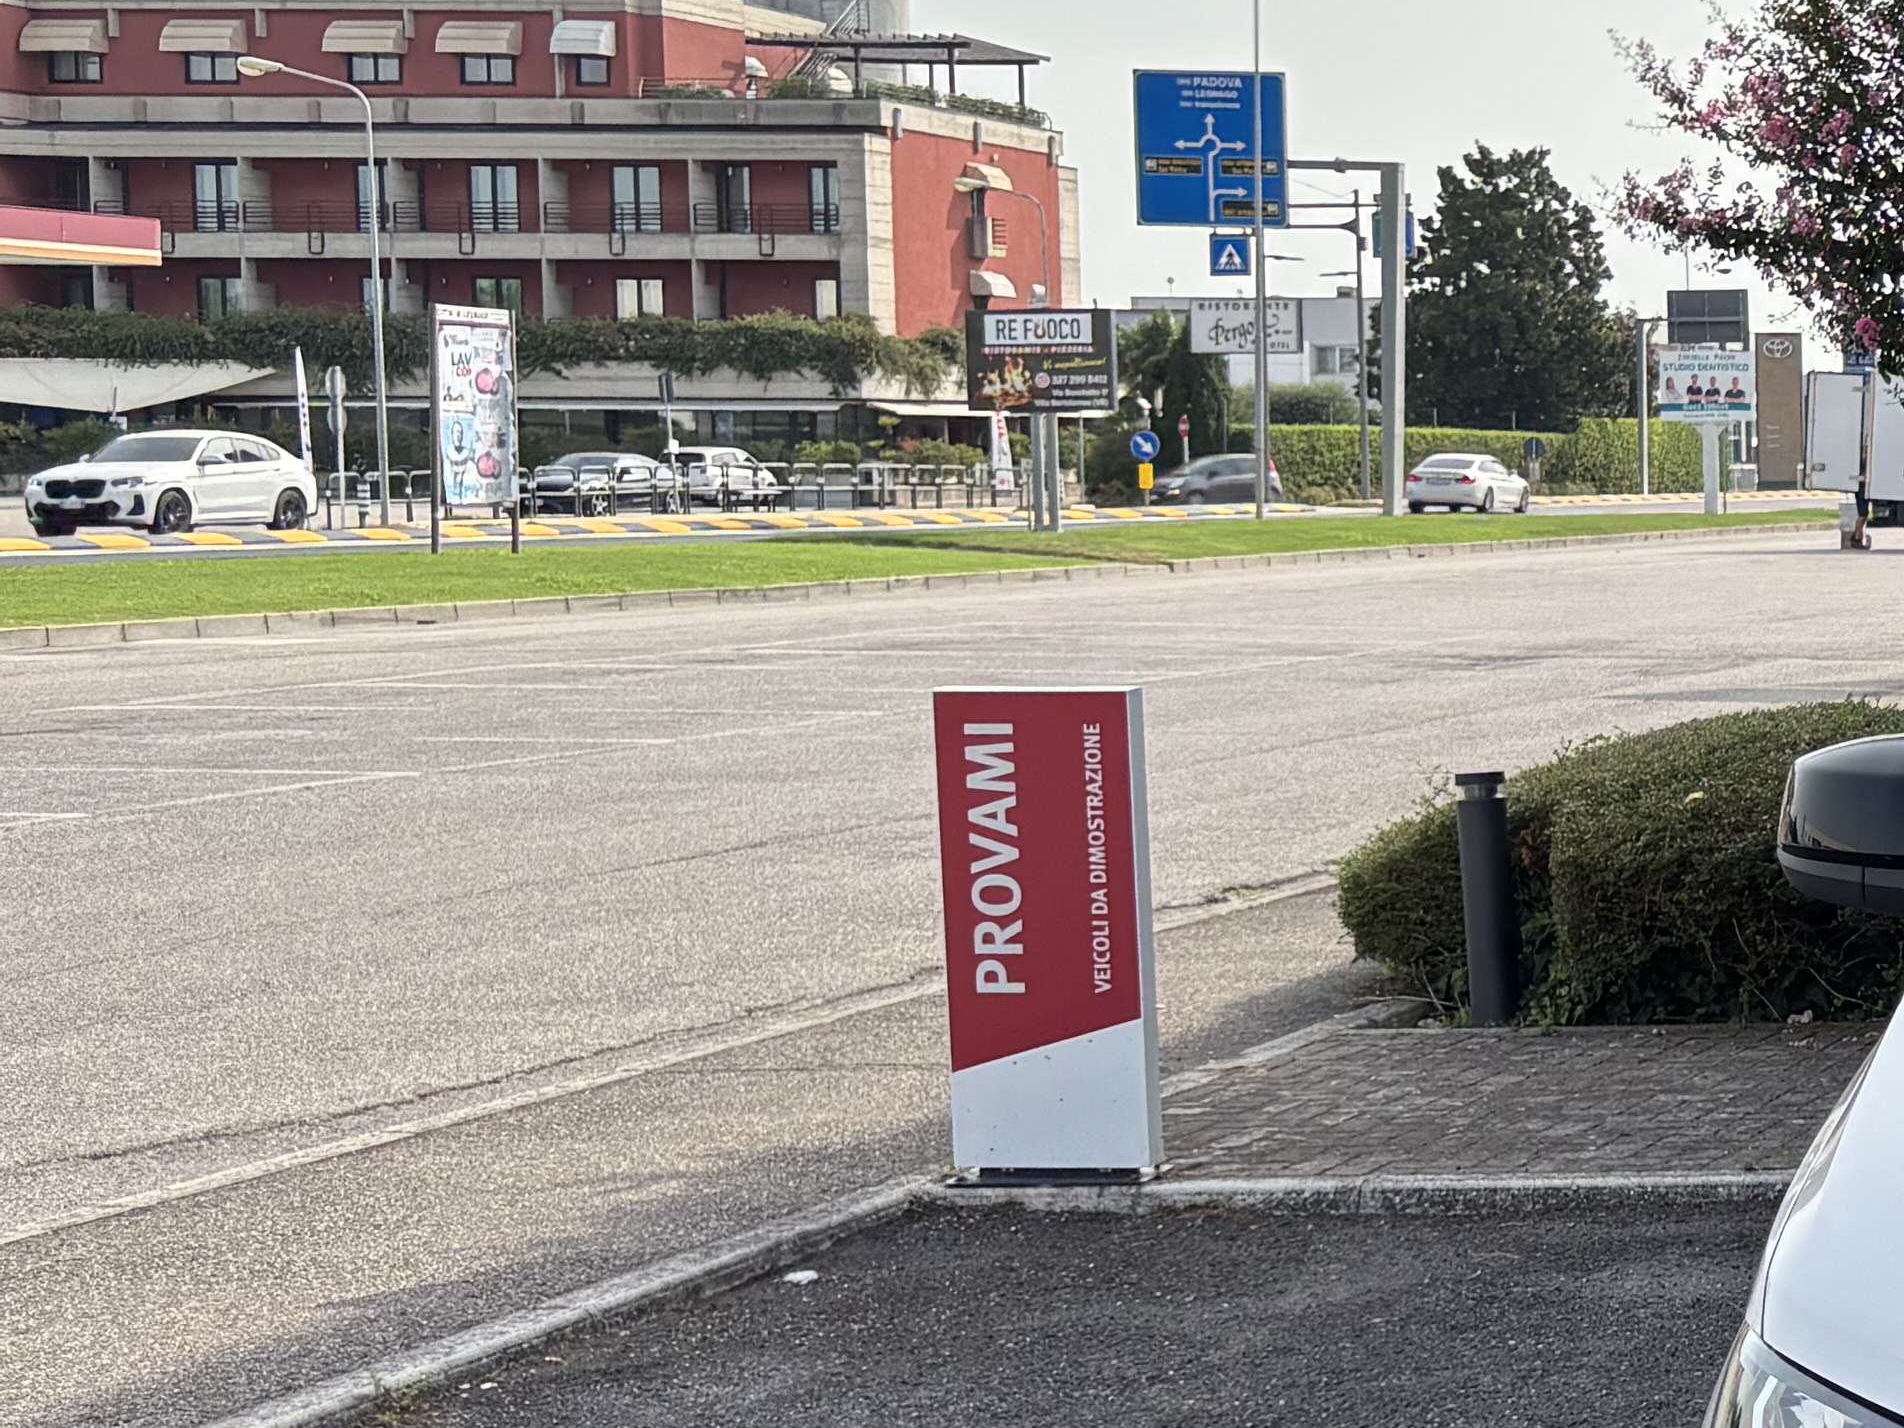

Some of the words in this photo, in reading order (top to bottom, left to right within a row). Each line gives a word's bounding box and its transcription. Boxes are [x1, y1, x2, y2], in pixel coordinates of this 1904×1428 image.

[1193, 77, 1242, 88] PADOVA
[1198, 302, 1289, 311] RISTORNTE
[995, 319, 1018, 341] RE
[1023, 318, 1081, 340] FUOCO
[1663, 363, 1696, 372] STUDIO
[1697, 363, 1750, 372] DENTISTICO
[1083, 722, 1107, 884] DIMOSTRAZIONE
[963, 722, 1026, 995] PROVAMI
[1091, 888, 1109, 915] DA
[1093, 919, 1113, 995] VEICOLI
